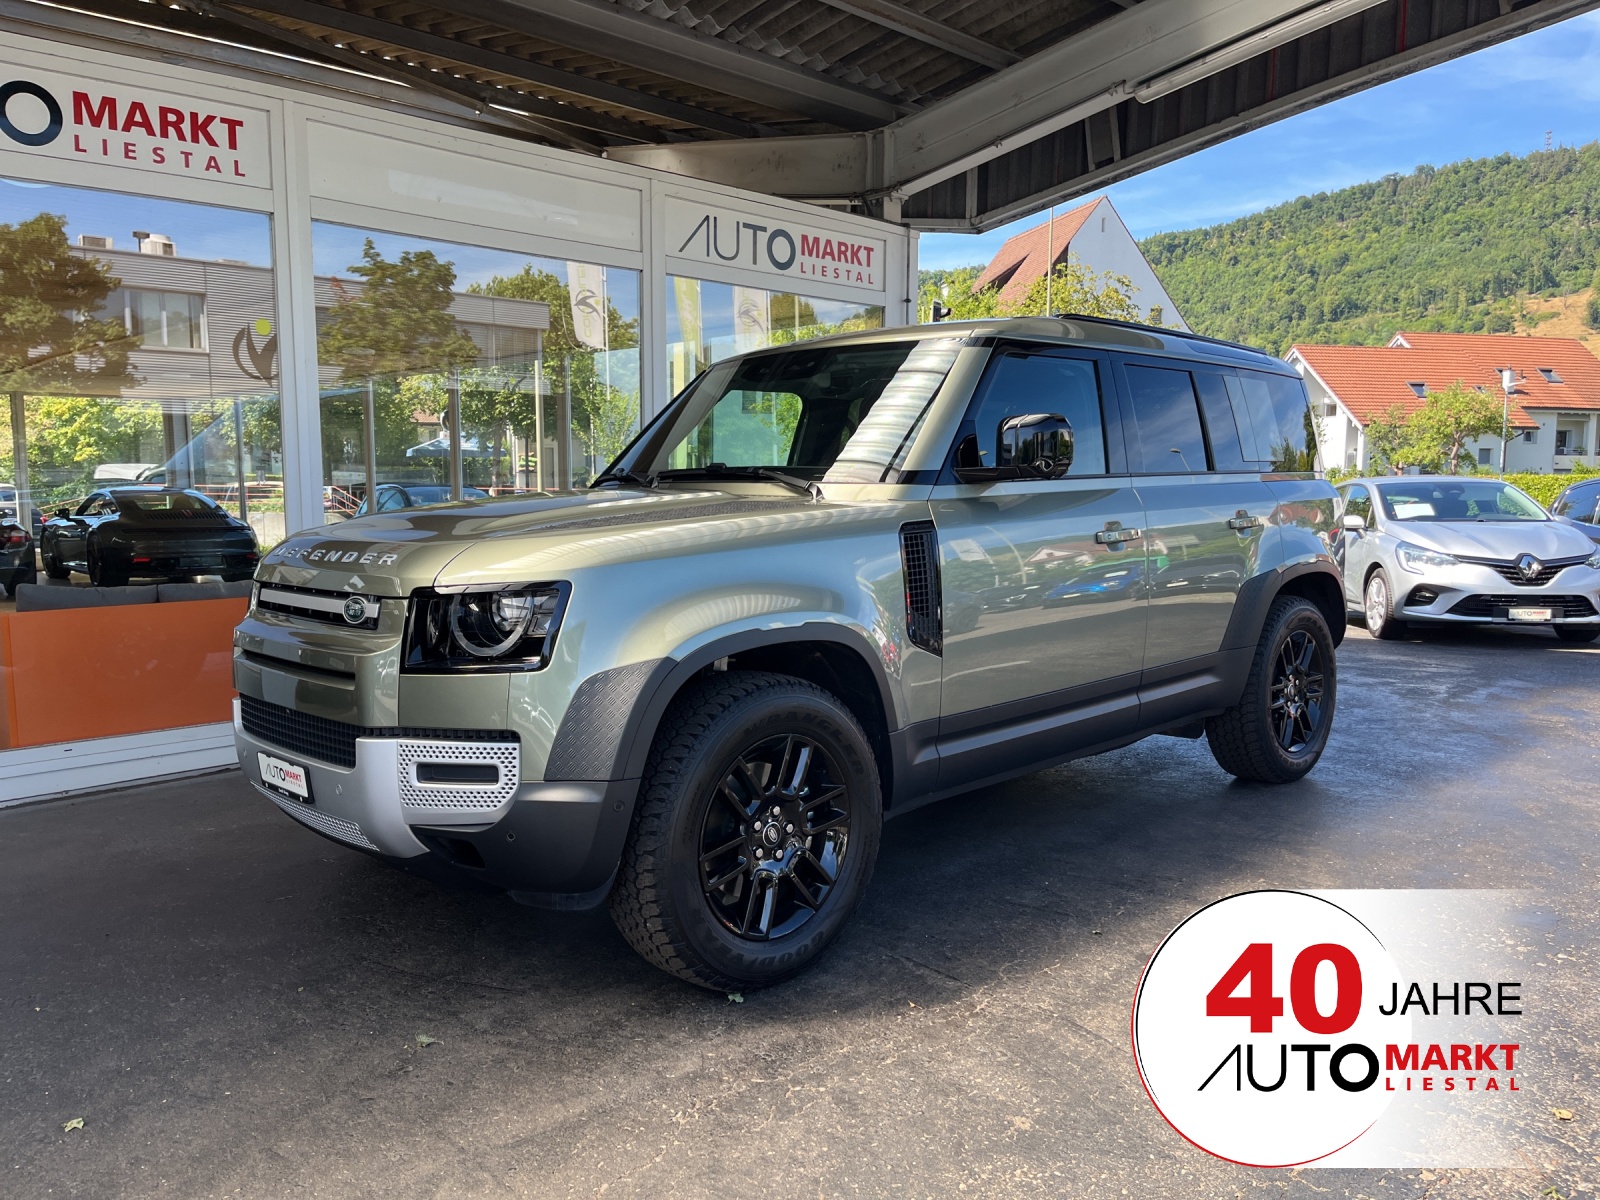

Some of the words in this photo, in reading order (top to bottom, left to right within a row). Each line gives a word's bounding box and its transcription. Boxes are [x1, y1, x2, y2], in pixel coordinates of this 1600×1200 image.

[72, 90, 244, 151] MARKT
[73, 134, 246, 177] LIESTAL
[678, 214, 796, 271] AUTO
[800, 233, 875, 268] MARKT
[800, 261, 874, 285] LIESTAL
[273, 547, 398, 567] DEFENDER
